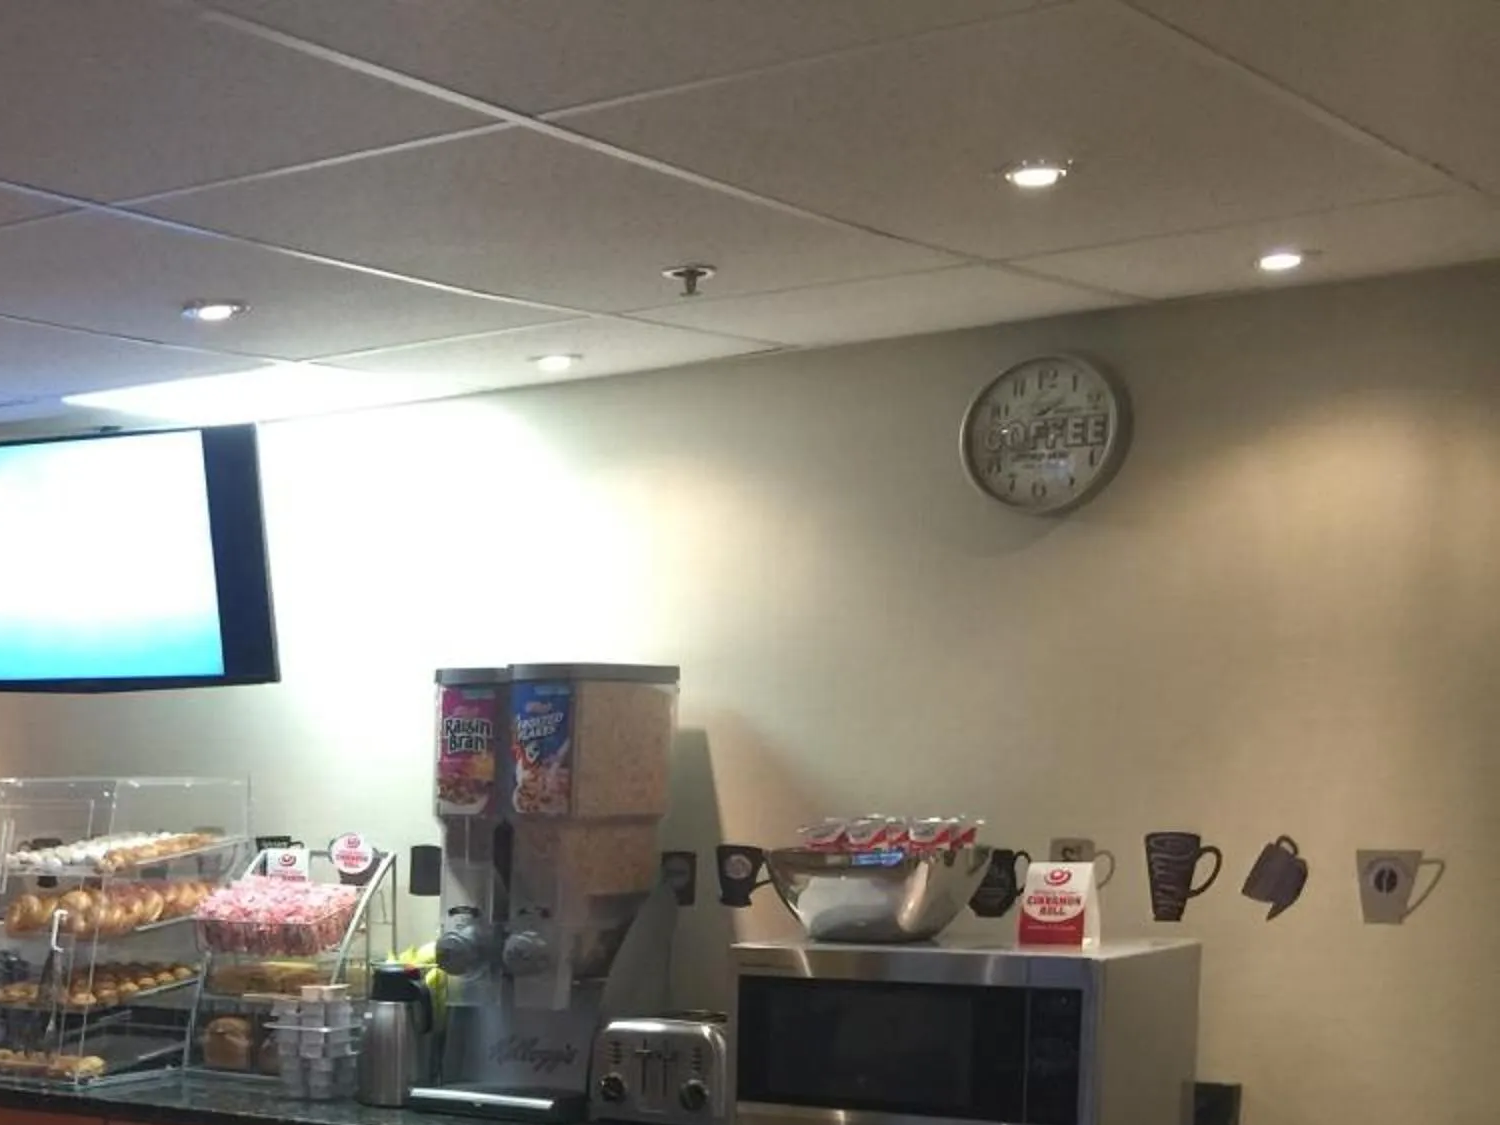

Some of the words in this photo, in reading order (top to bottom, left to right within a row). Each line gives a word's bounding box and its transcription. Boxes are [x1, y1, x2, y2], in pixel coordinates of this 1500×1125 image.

[1038, 369, 1059, 391] 12
[986, 415, 1108, 453] COFFEE
[444, 717, 493, 738] Raisin
[448, 733, 488, 753] Bran
[1027, 895, 1082, 907] CINNAMON
